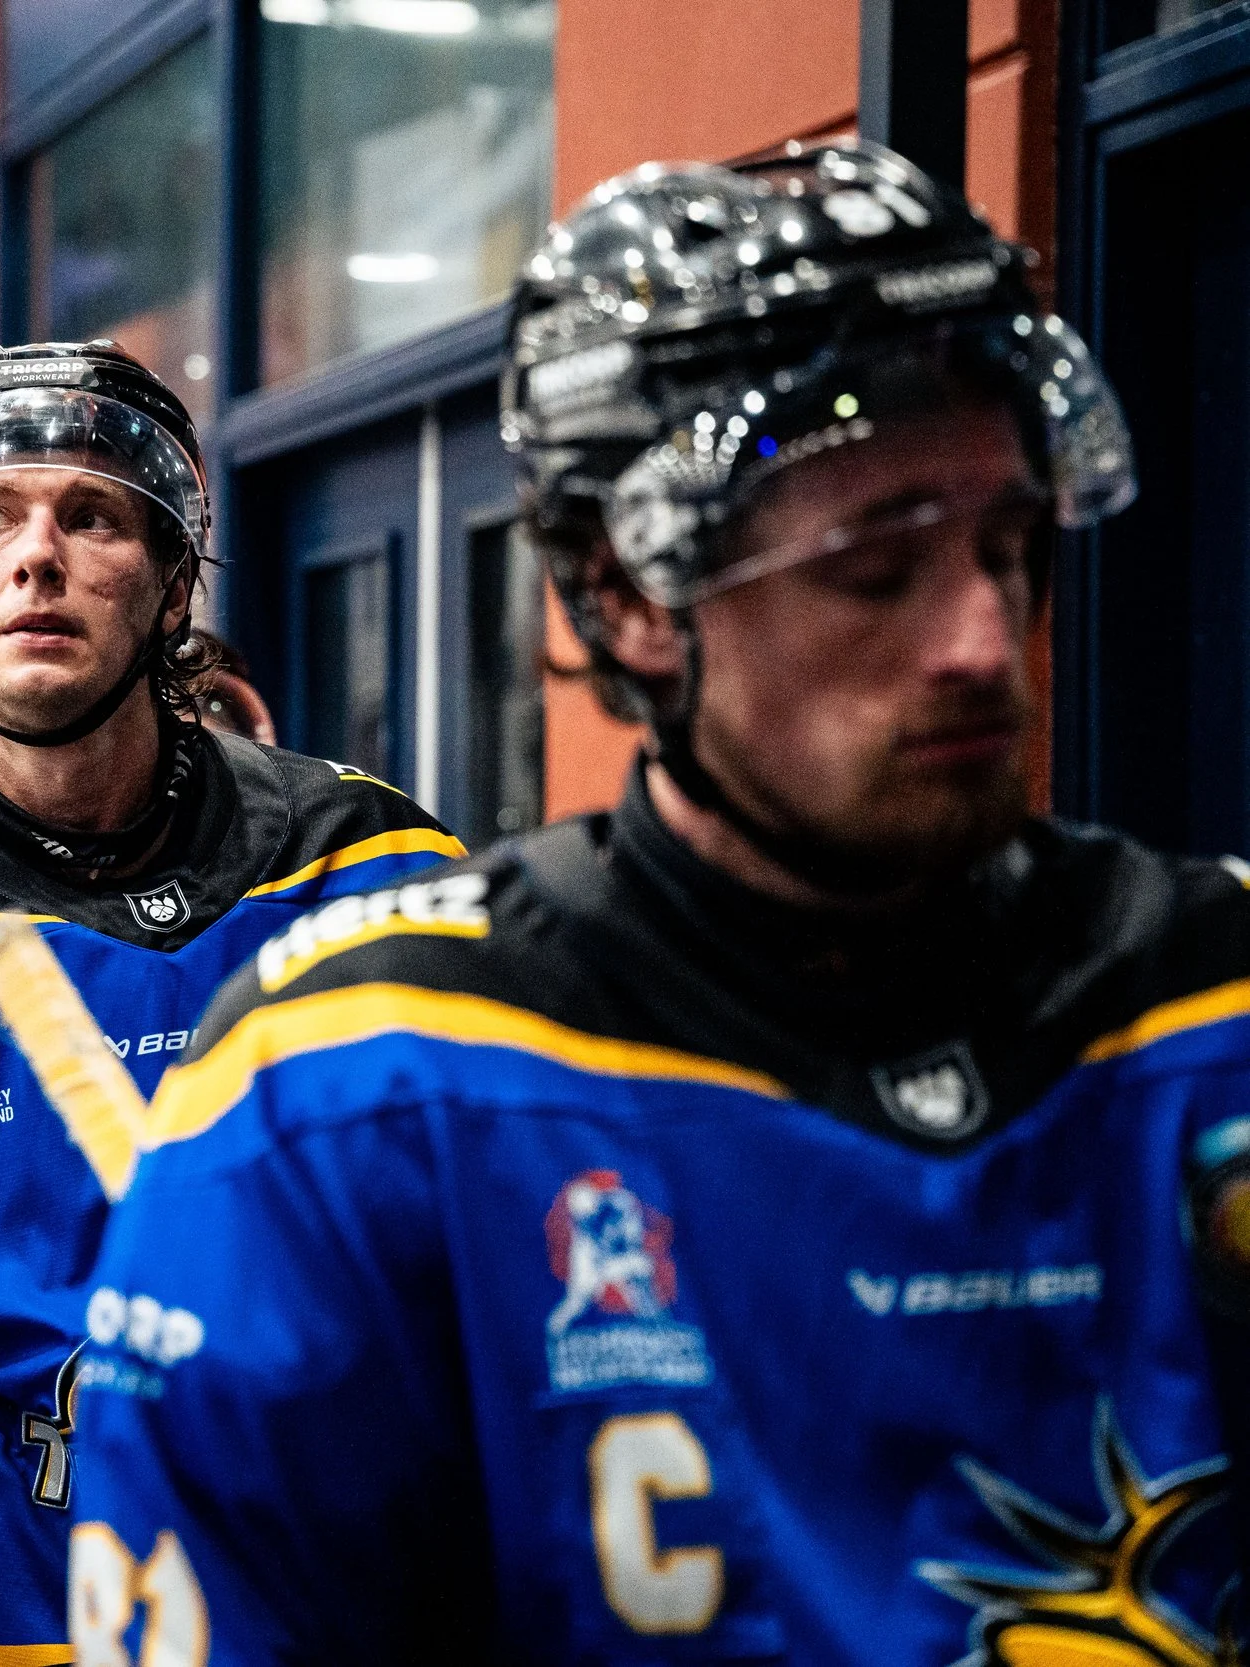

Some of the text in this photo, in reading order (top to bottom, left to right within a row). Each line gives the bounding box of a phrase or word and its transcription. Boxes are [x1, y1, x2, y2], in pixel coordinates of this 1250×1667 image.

[1, 362, 84, 376] TRICORP
[12, 373, 71, 382] WORKWEAR
[588, 1411, 725, 1635] C
